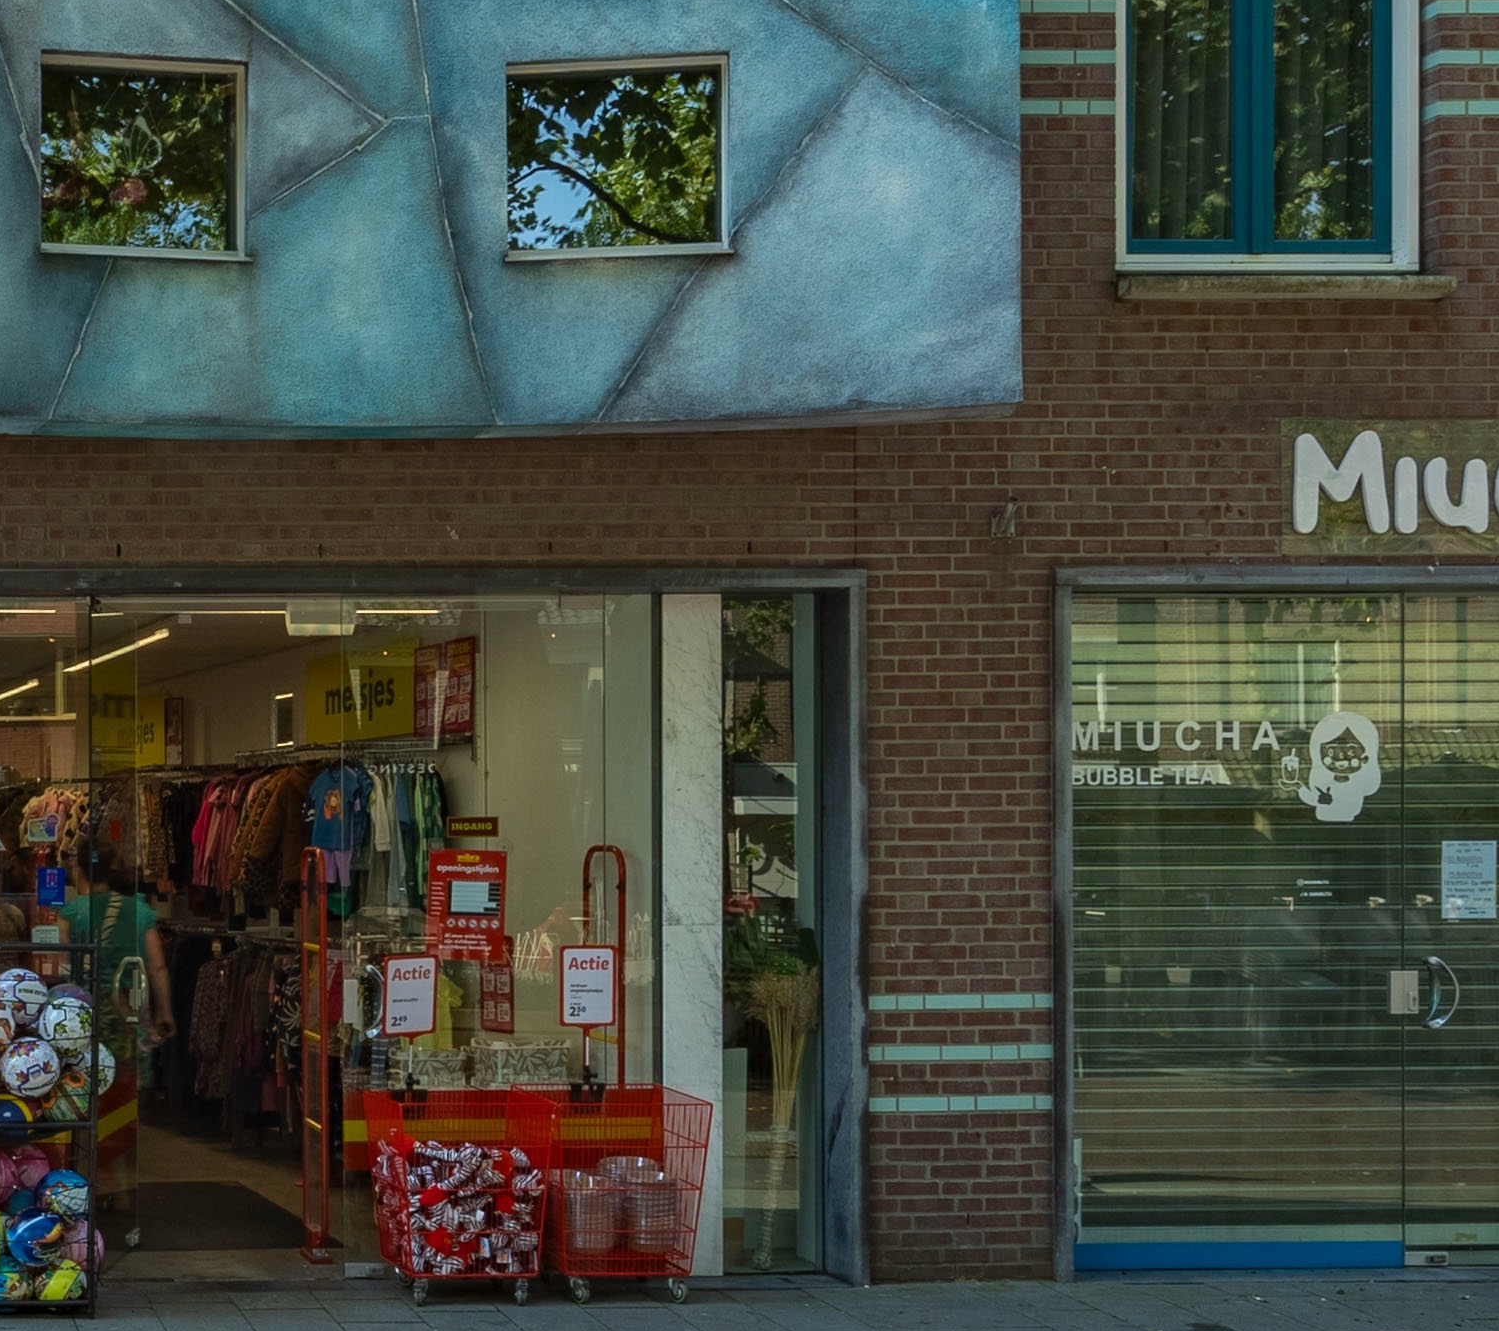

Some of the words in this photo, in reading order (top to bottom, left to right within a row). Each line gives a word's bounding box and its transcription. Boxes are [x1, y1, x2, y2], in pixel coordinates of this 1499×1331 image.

[1071, 720, 1281, 752] MIUCHA
[1071, 767, 1164, 785] BUBBLE
[1172, 767, 1217, 785] TEA
[568, 955, 610, 971] Actie
[391, 965, 432, 982] Actie
